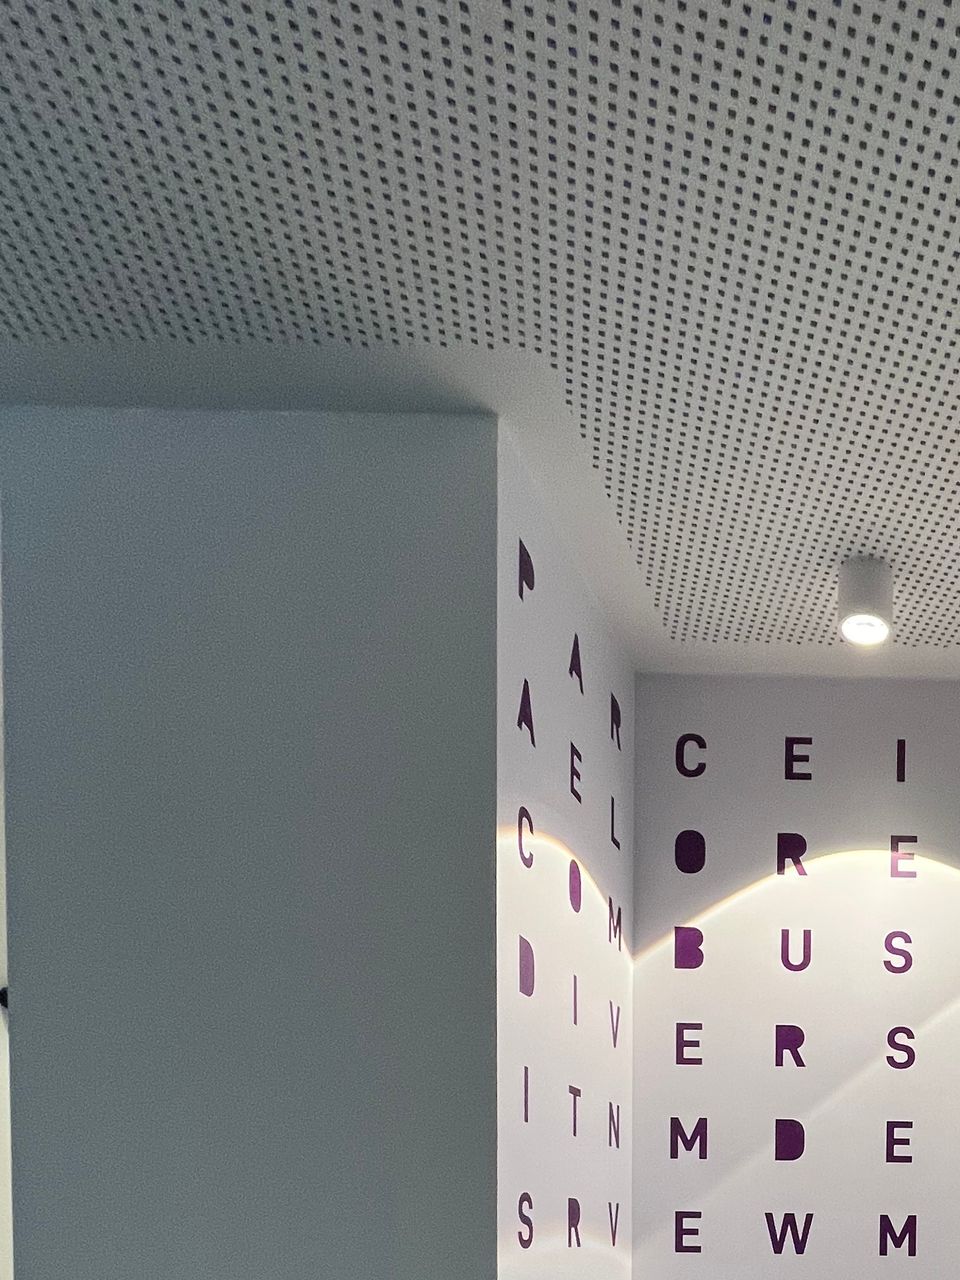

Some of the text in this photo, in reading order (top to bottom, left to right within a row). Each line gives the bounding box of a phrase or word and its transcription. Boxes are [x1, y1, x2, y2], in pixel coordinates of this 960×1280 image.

[568, 632, 585, 696] A
[610, 691, 622, 752] R
[516, 677, 621, 851] A E L
[674, 732, 708, 779] C
[784, 735, 813, 781] E
[517, 805, 534, 869] C
[608, 895, 622, 953] M
[776, 832, 808, 876] R
[890, 834, 918, 879] E
[780, 928, 812, 972] U
[882, 930, 913, 975] S
[609, 1000, 621, 1049] V
[675, 1022, 703, 1066] E
[774, 1024, 807, 1068] R
[885, 1026, 916, 1070] S
[568, 1084, 582, 1138] T
[608, 1101, 620, 1149] N
[669, 1116, 708, 1160] M
[885, 1120, 914, 1164] E
[517, 1191, 620, 1250] S R V
[674, 1210, 703, 1254] E
[764, 1212, 815, 1255] W
[878, 1214, 918, 1257] M
